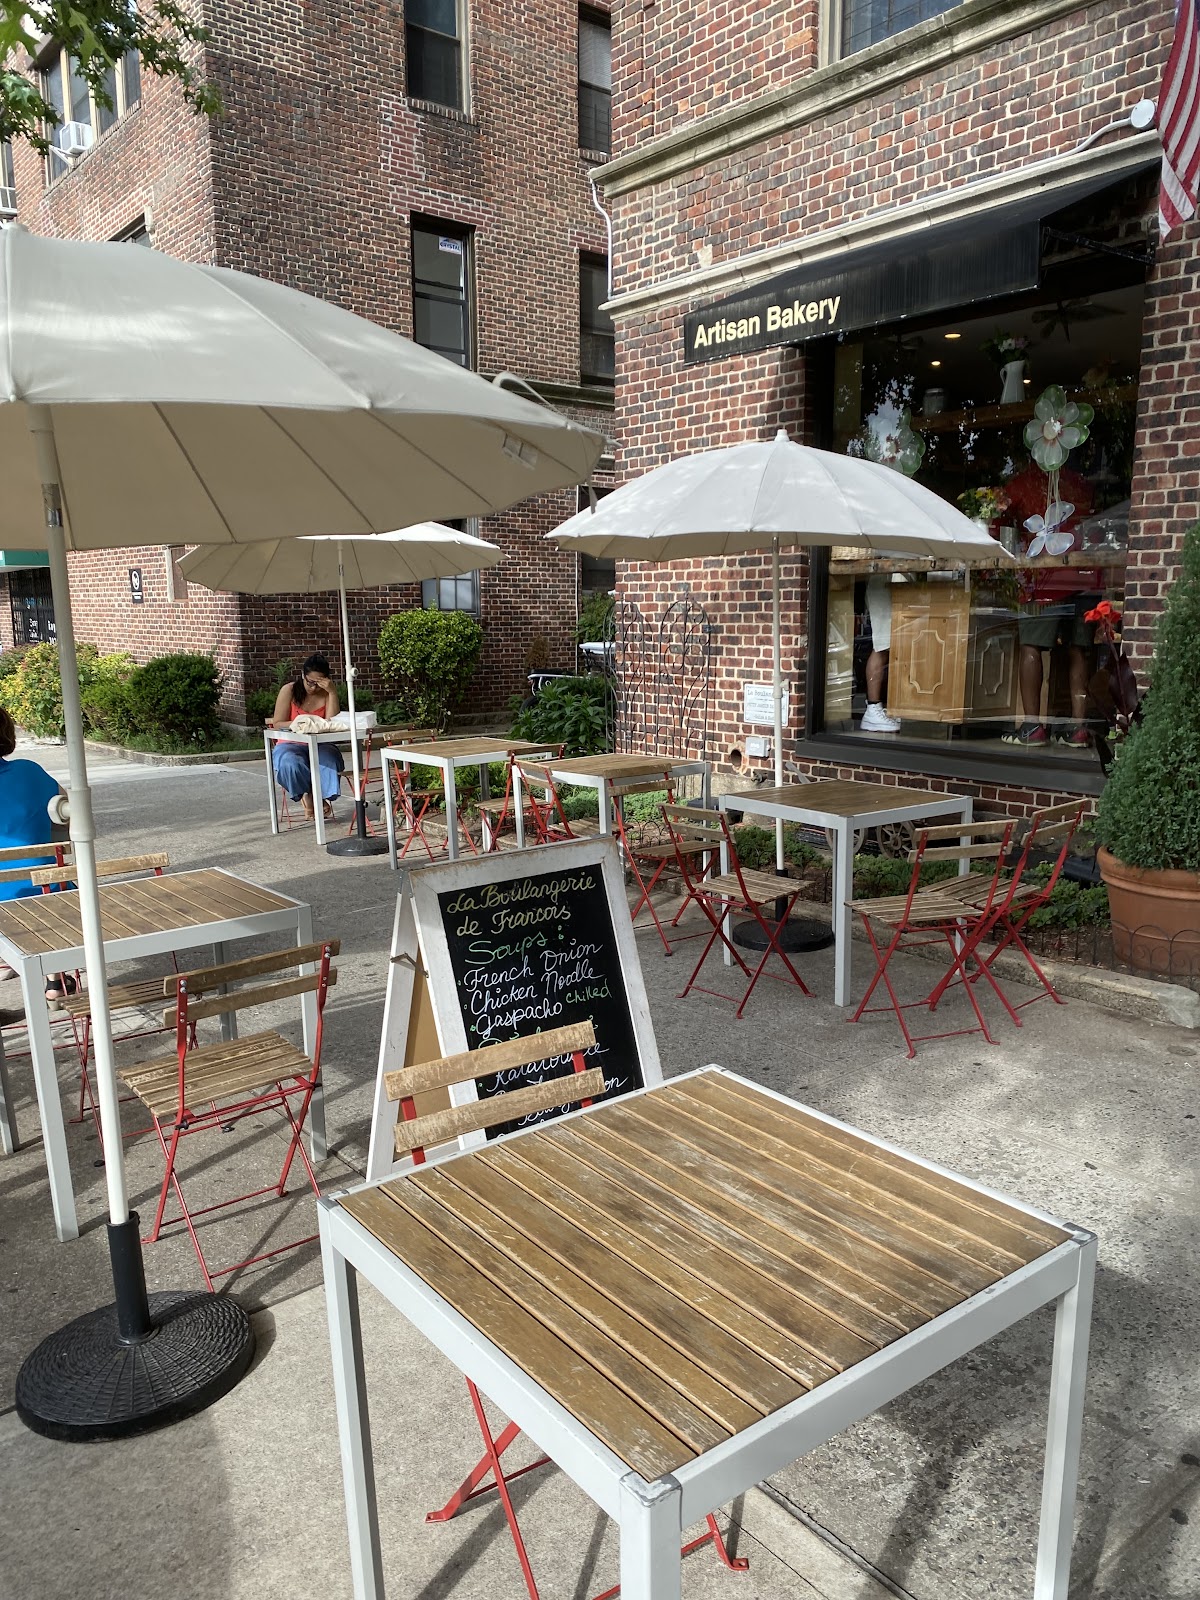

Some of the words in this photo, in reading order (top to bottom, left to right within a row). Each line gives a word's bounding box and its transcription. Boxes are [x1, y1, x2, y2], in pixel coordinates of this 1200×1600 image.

[440, 241, 460, 250] CRYSTAL
[694, 315, 761, 349] Artisan
[767, 295, 841, 332] Bakery
[447, 893, 480, 913] La
[480, 872, 596, 908] Boulangerie
[457, 916, 482, 936] de
[491, 903, 571, 934] Francois
[464, 955, 534, 992] French
[540, 938, 603, 971] Onion
[471, 985, 538, 1016] Chicken
[541, 959, 606, 994] Noodle
[476, 997, 562, 1039] Gaspacho
